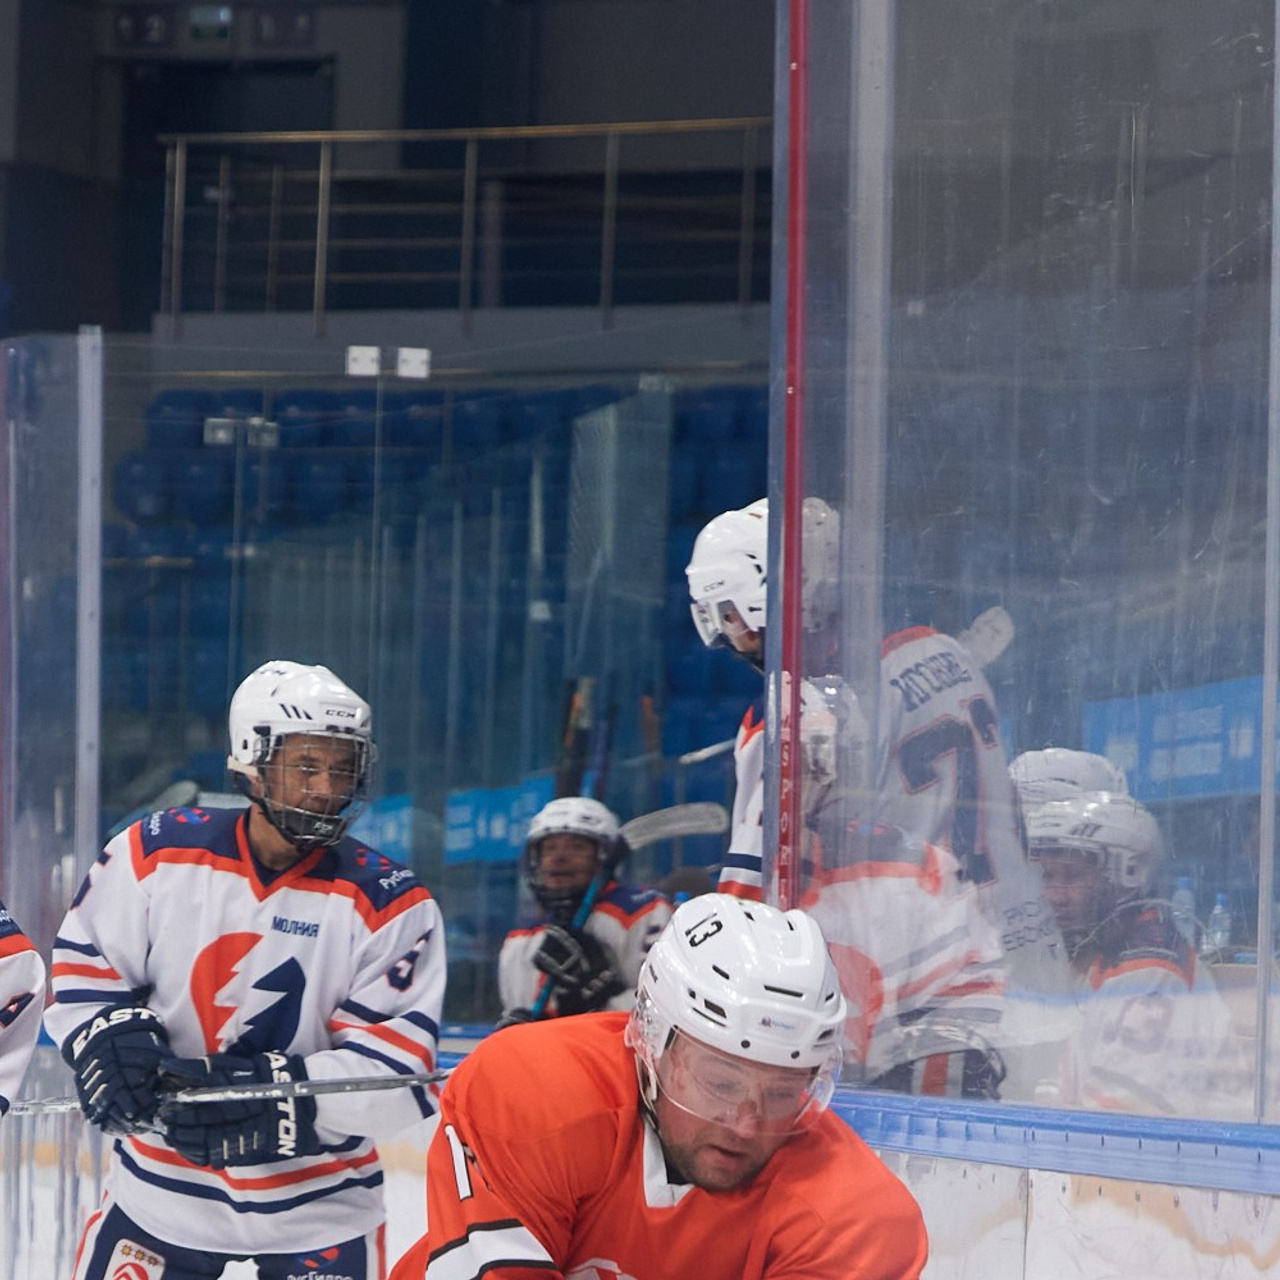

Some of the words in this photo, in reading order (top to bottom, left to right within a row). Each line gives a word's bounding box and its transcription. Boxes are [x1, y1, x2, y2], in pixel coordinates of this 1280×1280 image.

[271, 915, 320, 939] МОЛНИЯ
[685, 912, 724, 948] 13
[72, 1007, 163, 1062] EAST
[263, 1050, 297, 1157] ASTON
